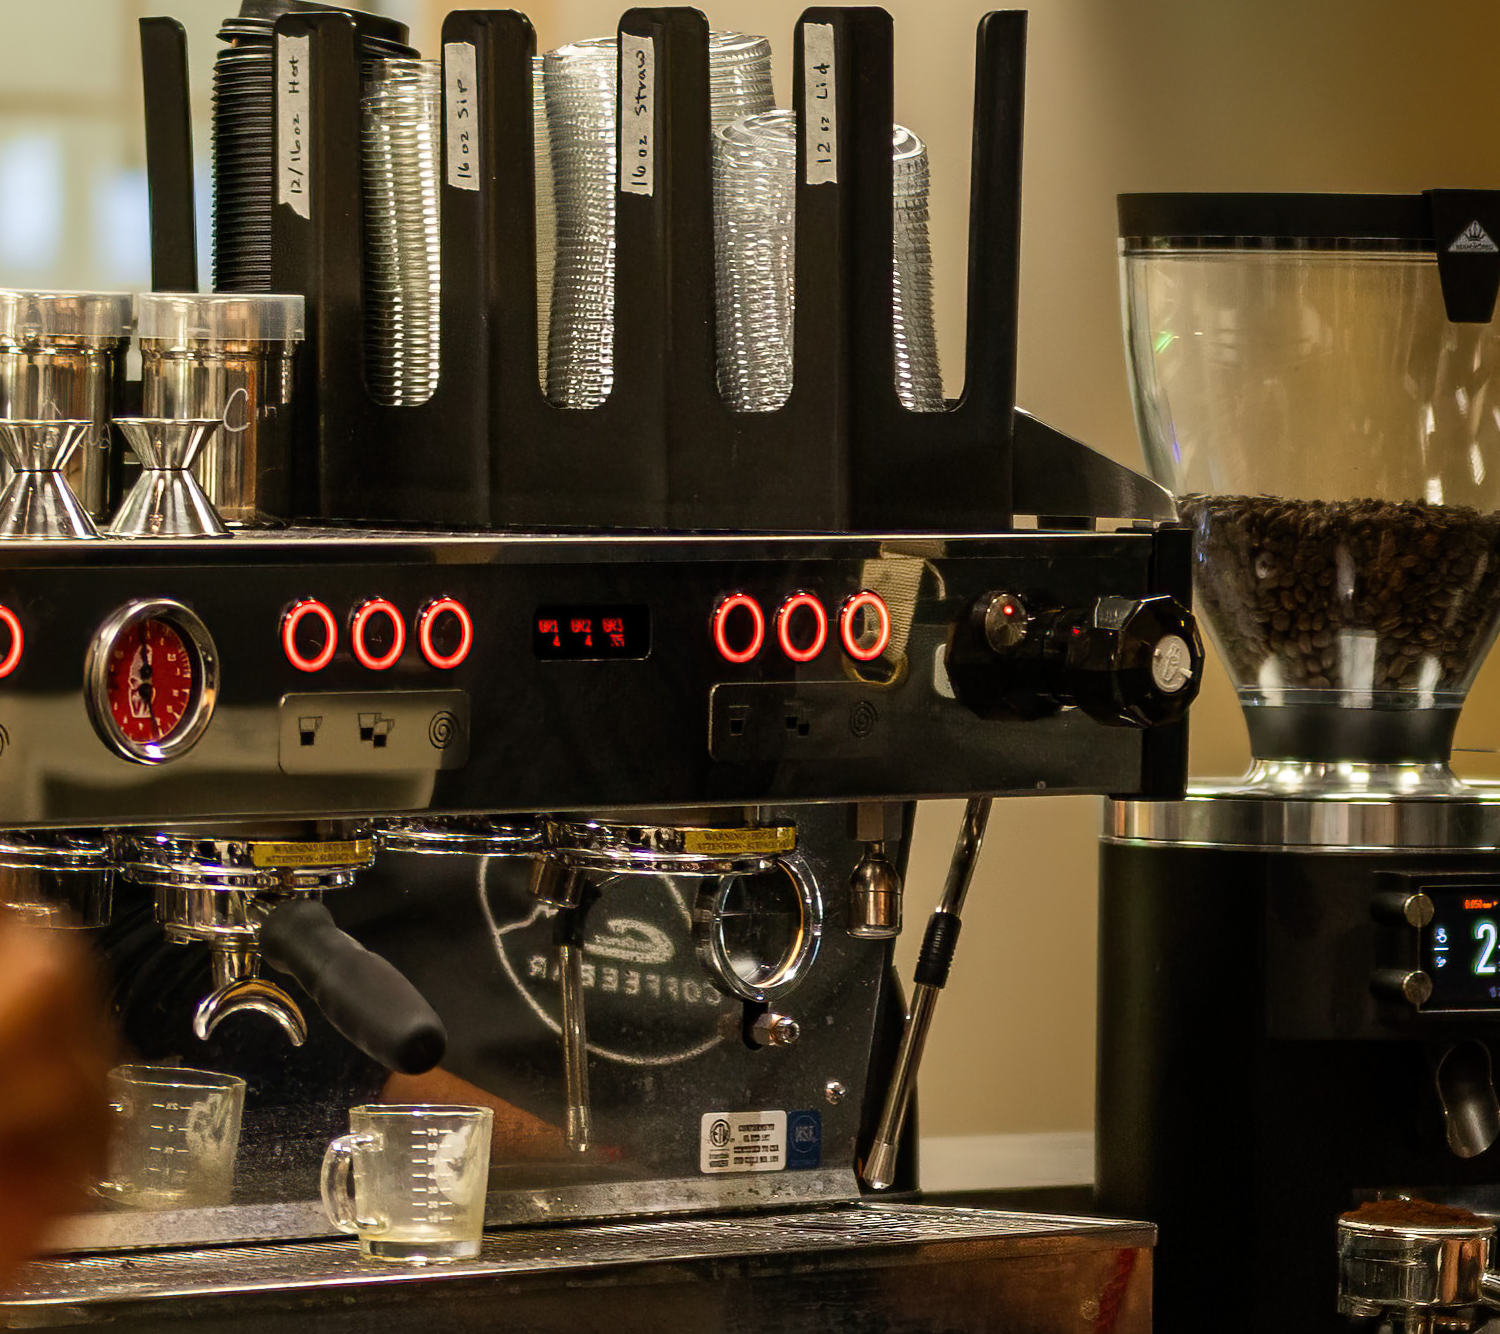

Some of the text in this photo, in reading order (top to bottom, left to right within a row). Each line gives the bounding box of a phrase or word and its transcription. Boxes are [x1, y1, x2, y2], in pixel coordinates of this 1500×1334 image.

[289, 55, 300, 94] Hot
[630, 50, 648, 186] 16 oz Straw
[460, 131, 469, 154] oz
[816, 141, 832, 164] 12
[457, 162, 472, 179] 16
